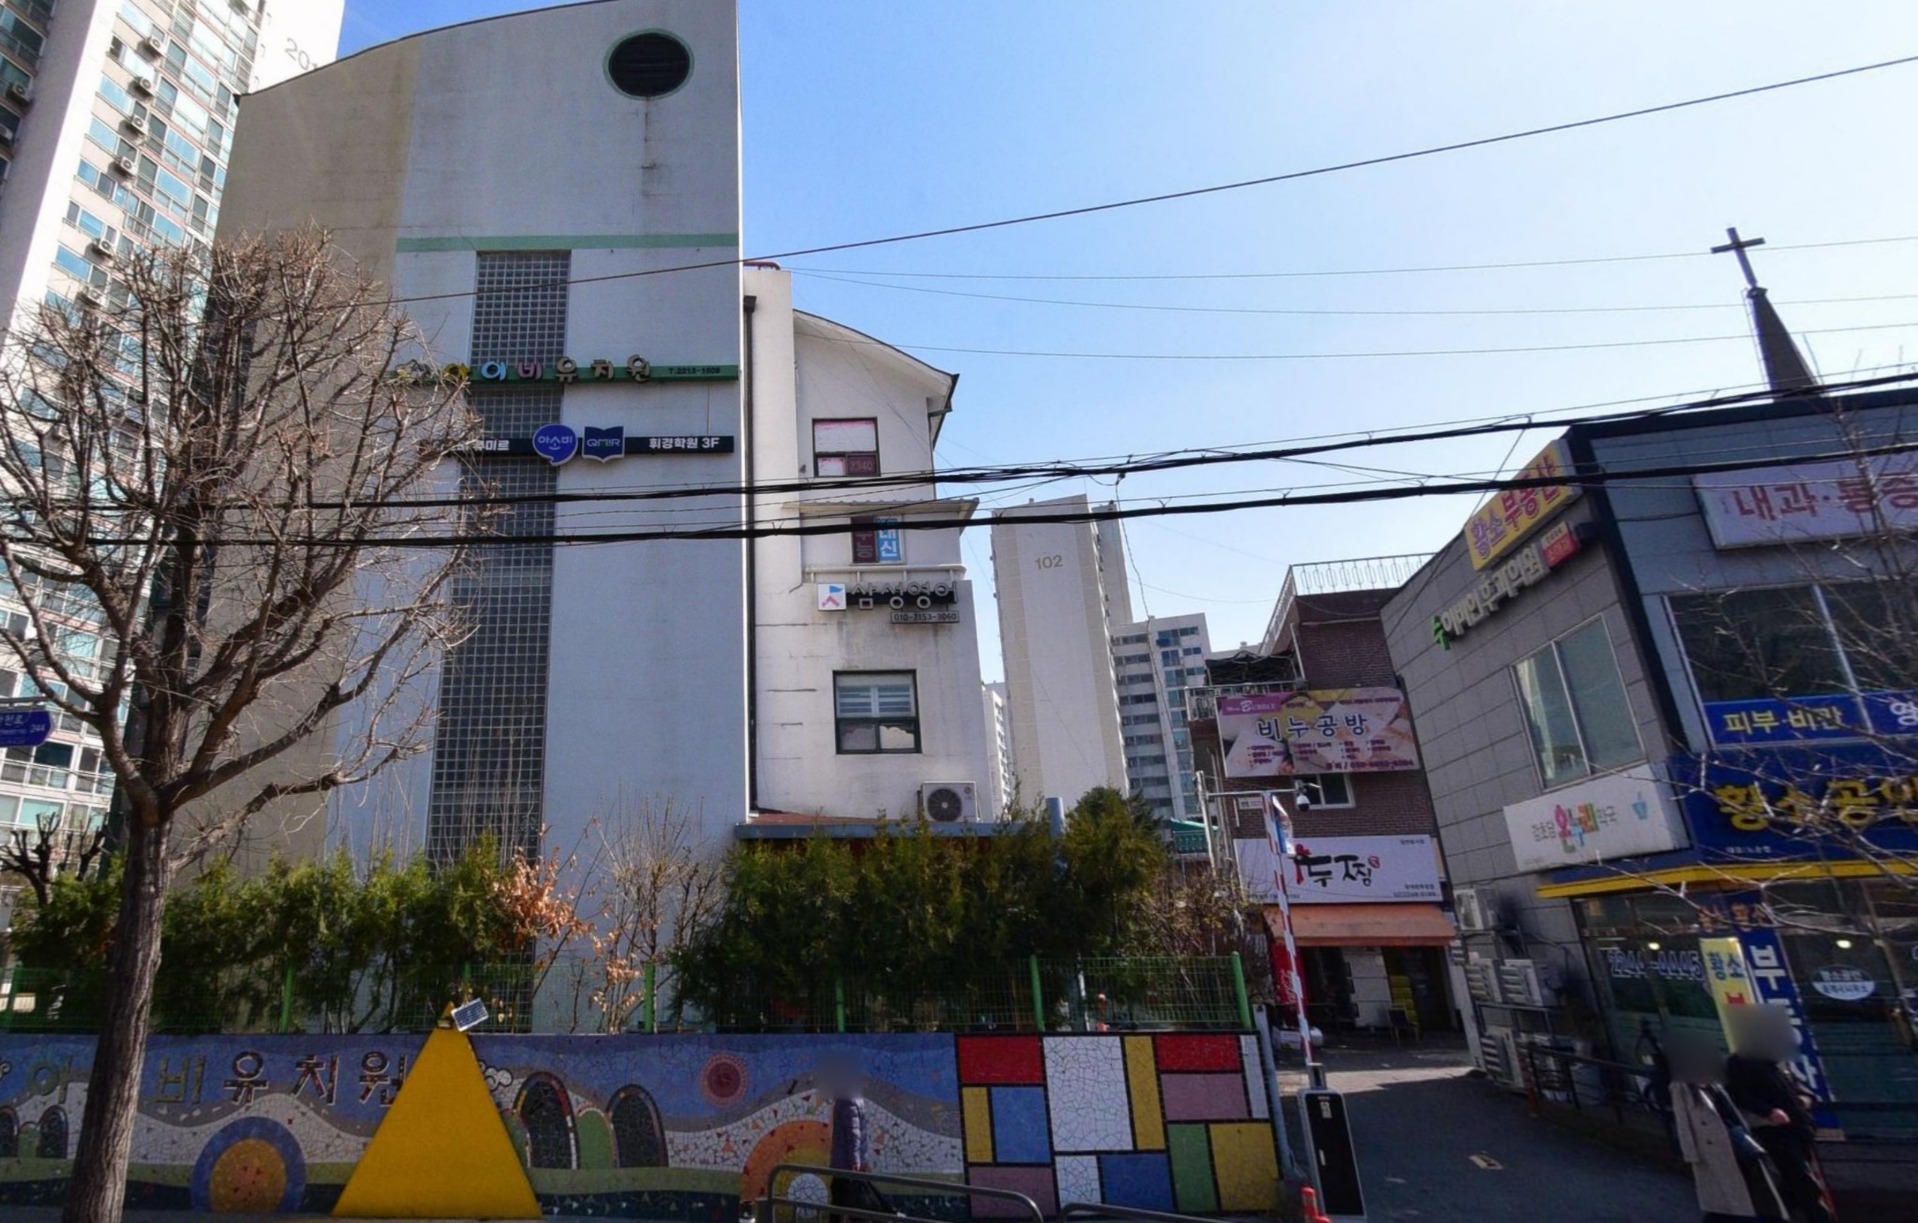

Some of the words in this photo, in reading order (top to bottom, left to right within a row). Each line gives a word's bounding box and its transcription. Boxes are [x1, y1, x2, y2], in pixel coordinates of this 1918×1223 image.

[285, 37, 317, 70] 20
[649, 437, 699, 449] 휘경학원
[702, 437, 720, 449] 3F
[1035, 555, 1064, 570] 102
[1257, 713, 1368, 742] 비누공방
